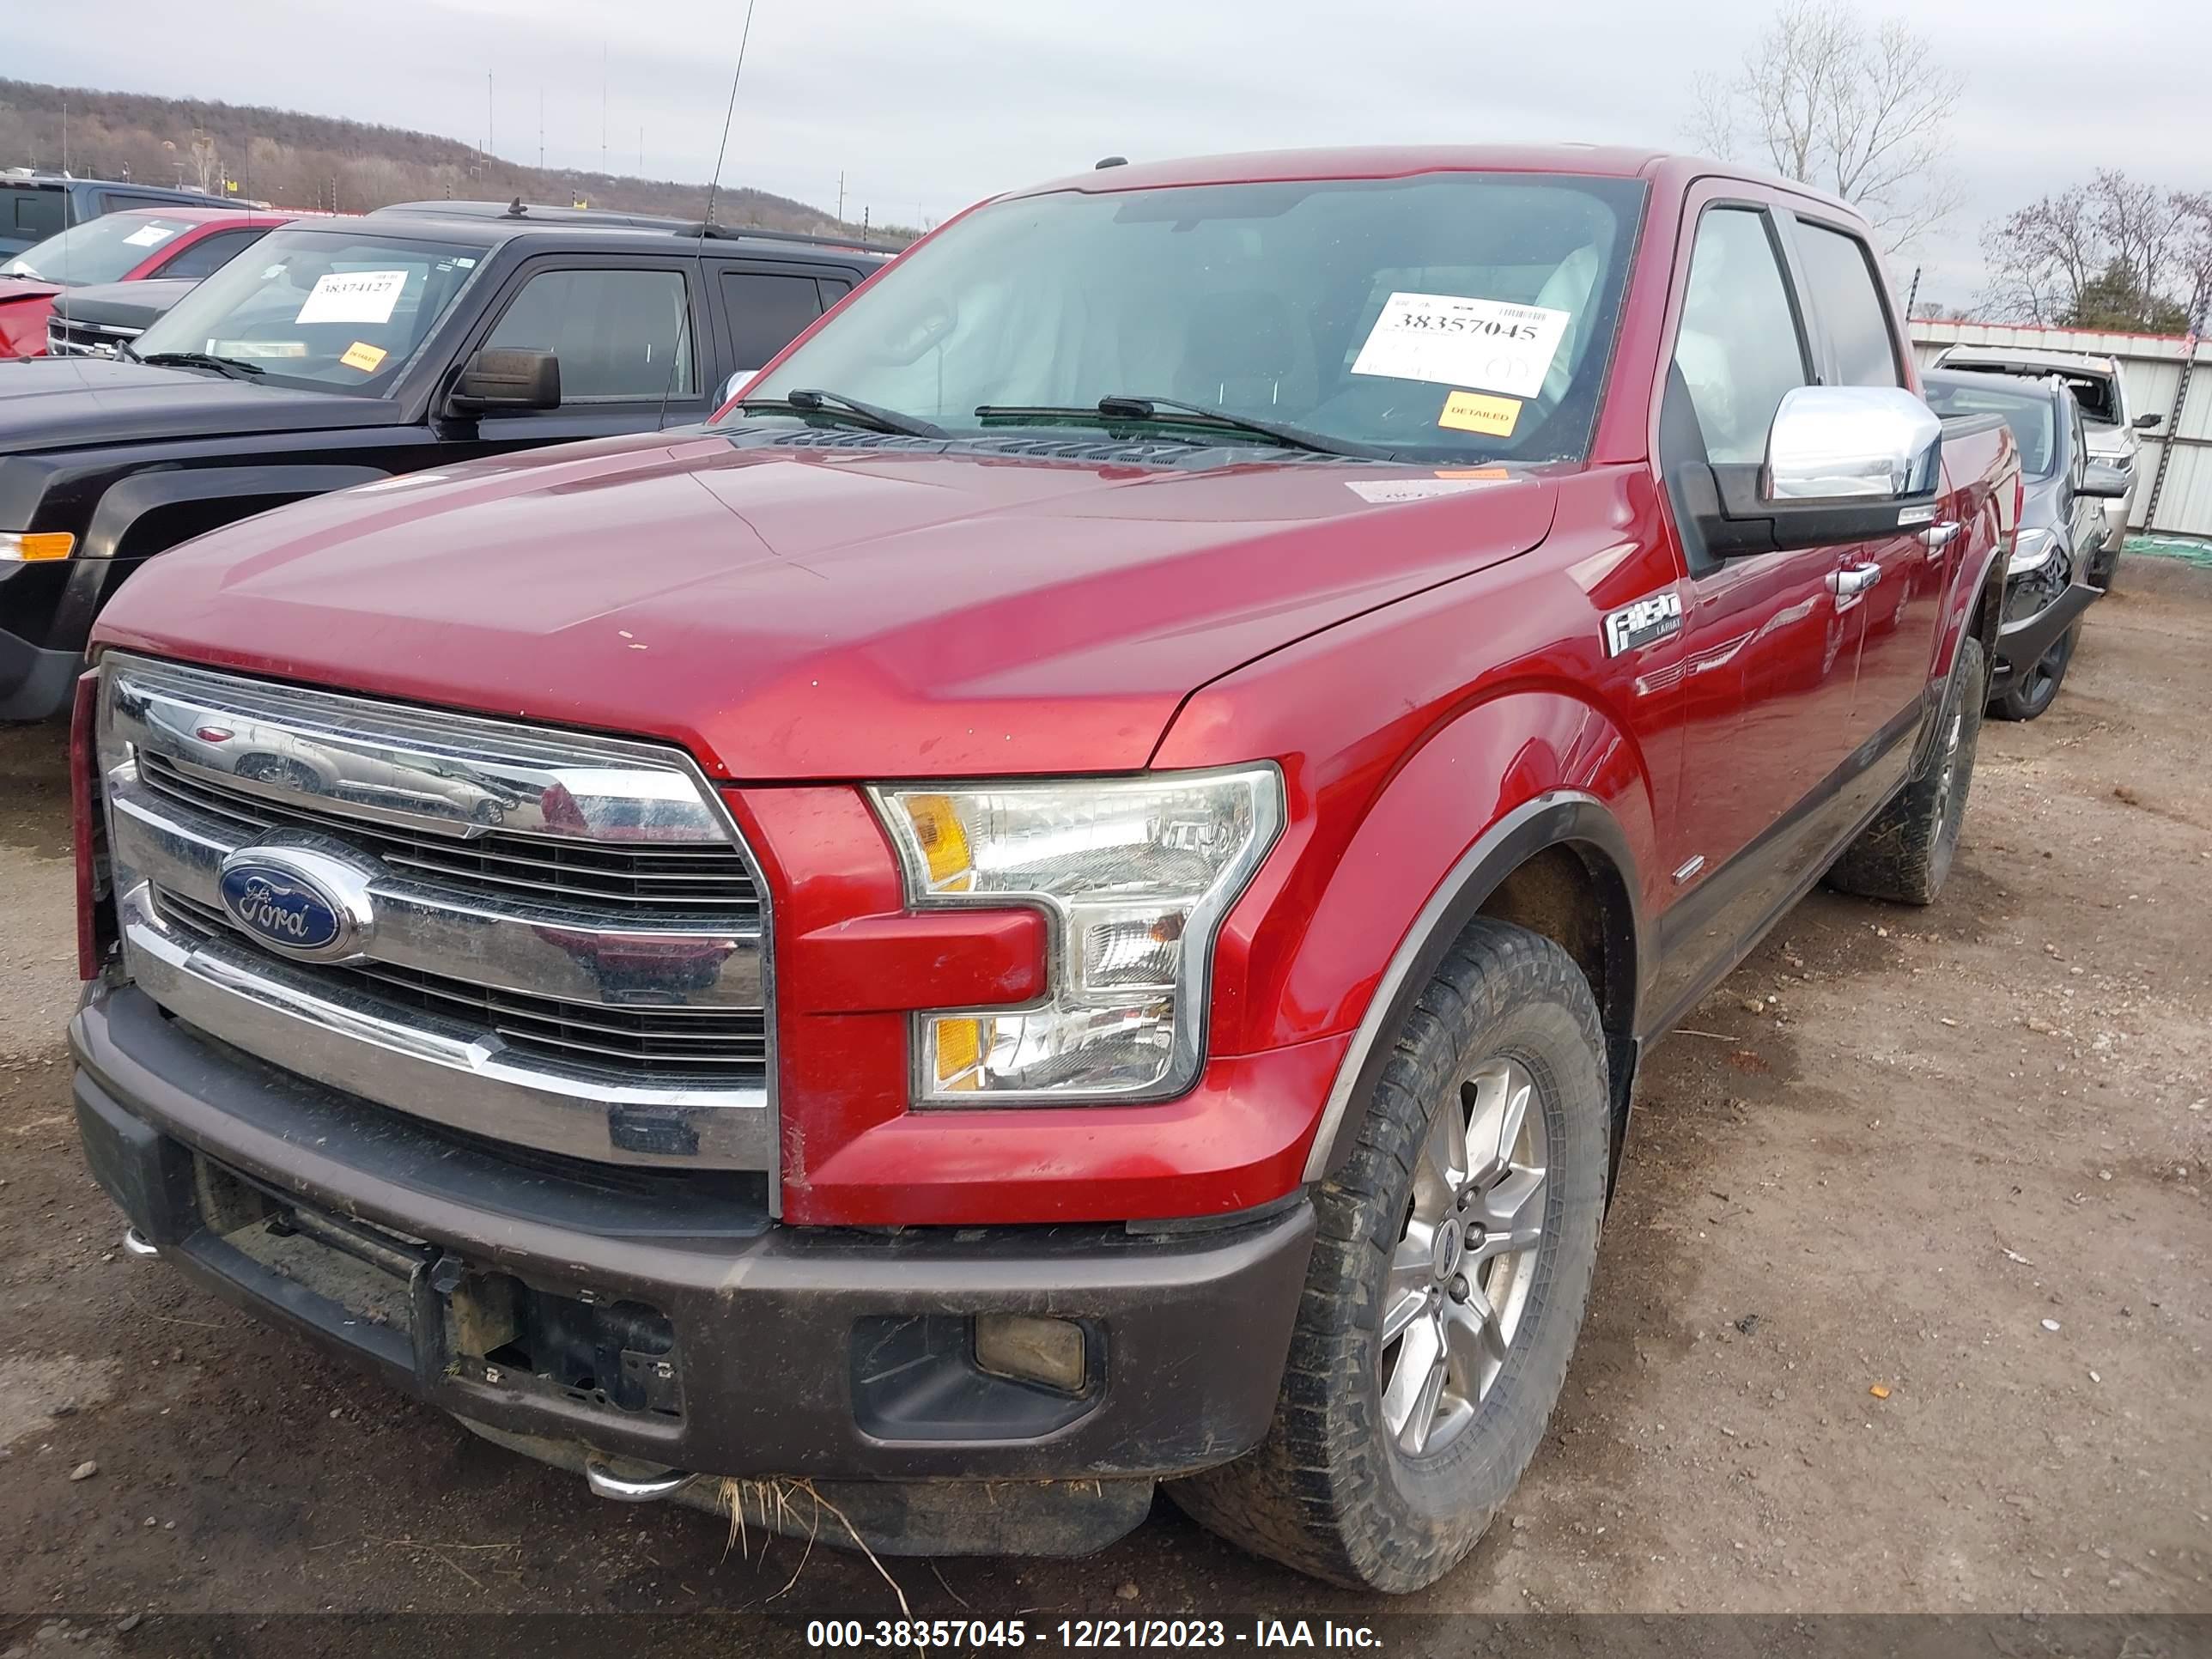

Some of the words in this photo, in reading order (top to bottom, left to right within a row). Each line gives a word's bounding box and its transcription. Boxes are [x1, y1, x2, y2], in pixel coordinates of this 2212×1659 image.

[1394, 312, 1540, 342] 38357045
[1450, 405, 1510, 422] DETAILED
[1656, 617, 1681, 636] LARIAT
[238, 874, 311, 939] Ford
